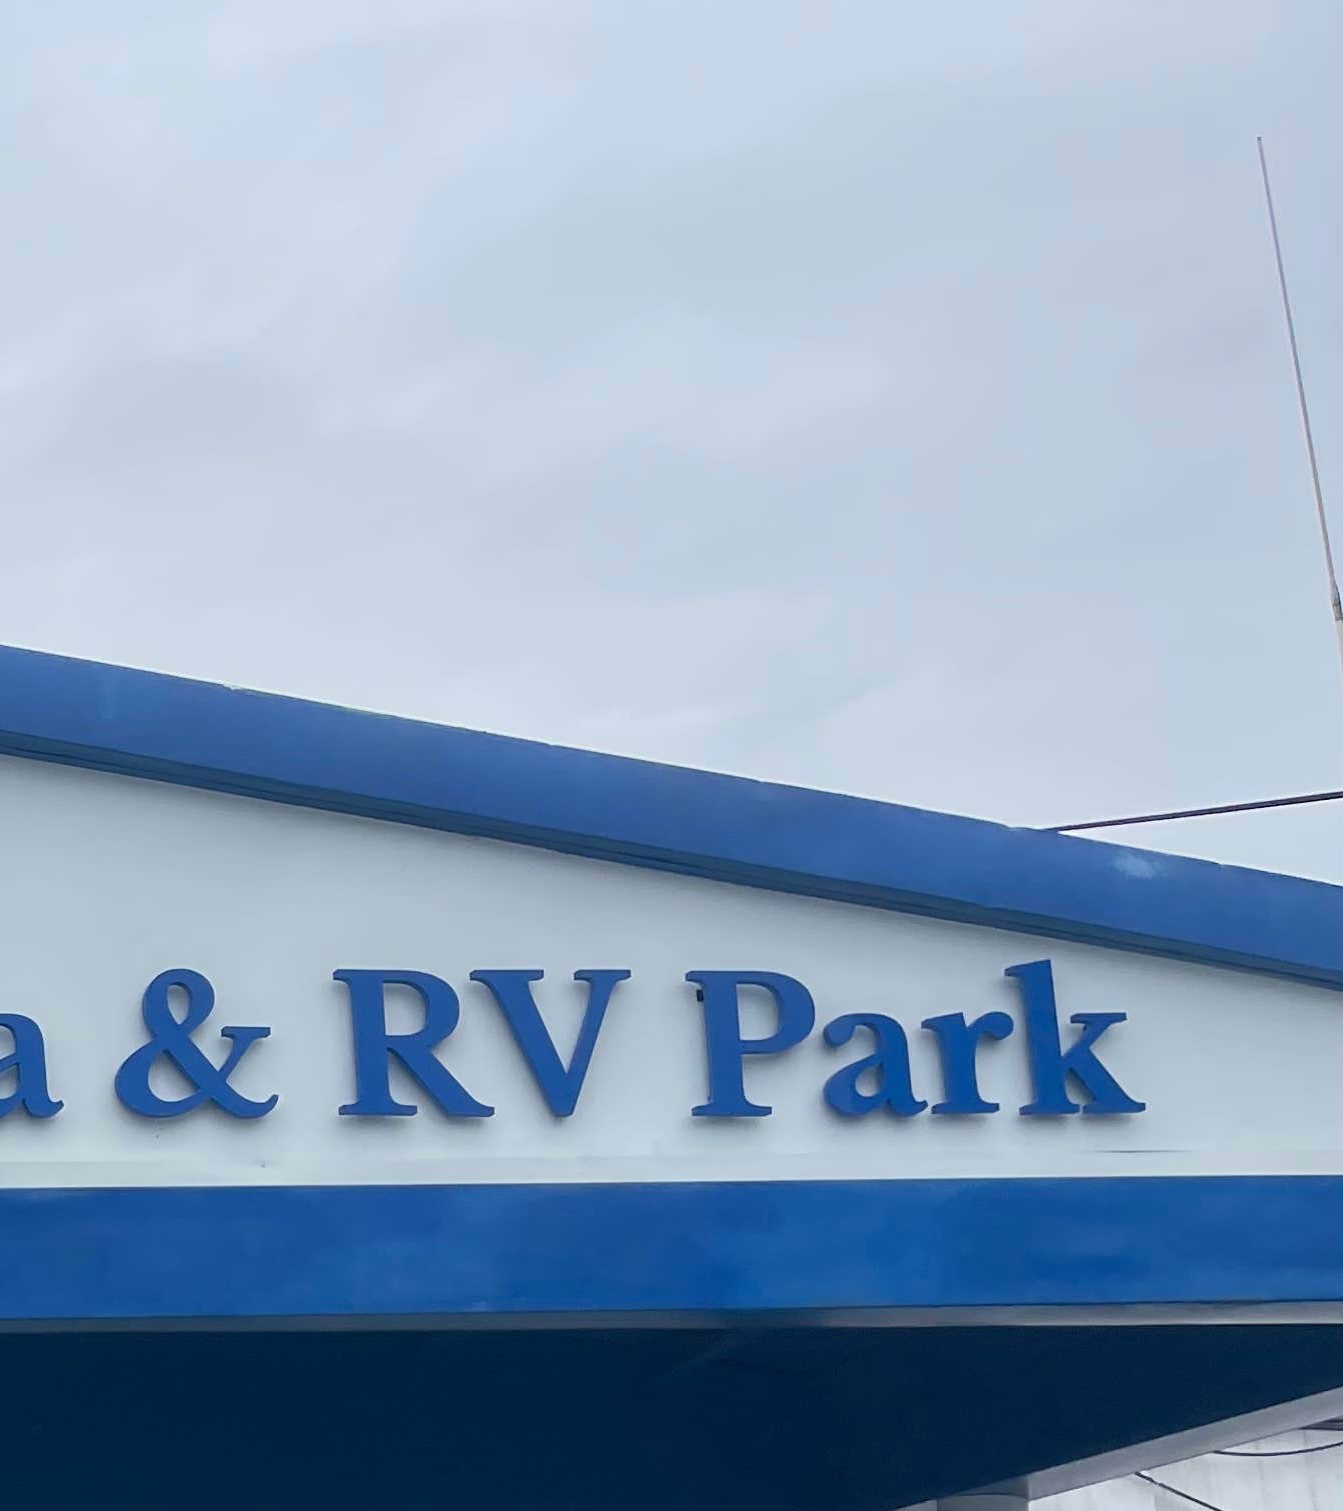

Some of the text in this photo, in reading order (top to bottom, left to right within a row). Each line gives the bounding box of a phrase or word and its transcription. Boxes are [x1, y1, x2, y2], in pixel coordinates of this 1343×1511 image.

[114, 968, 279, 1119] &
[334, 969, 629, 1118] RV
[688, 960, 1146, 1118] Park
